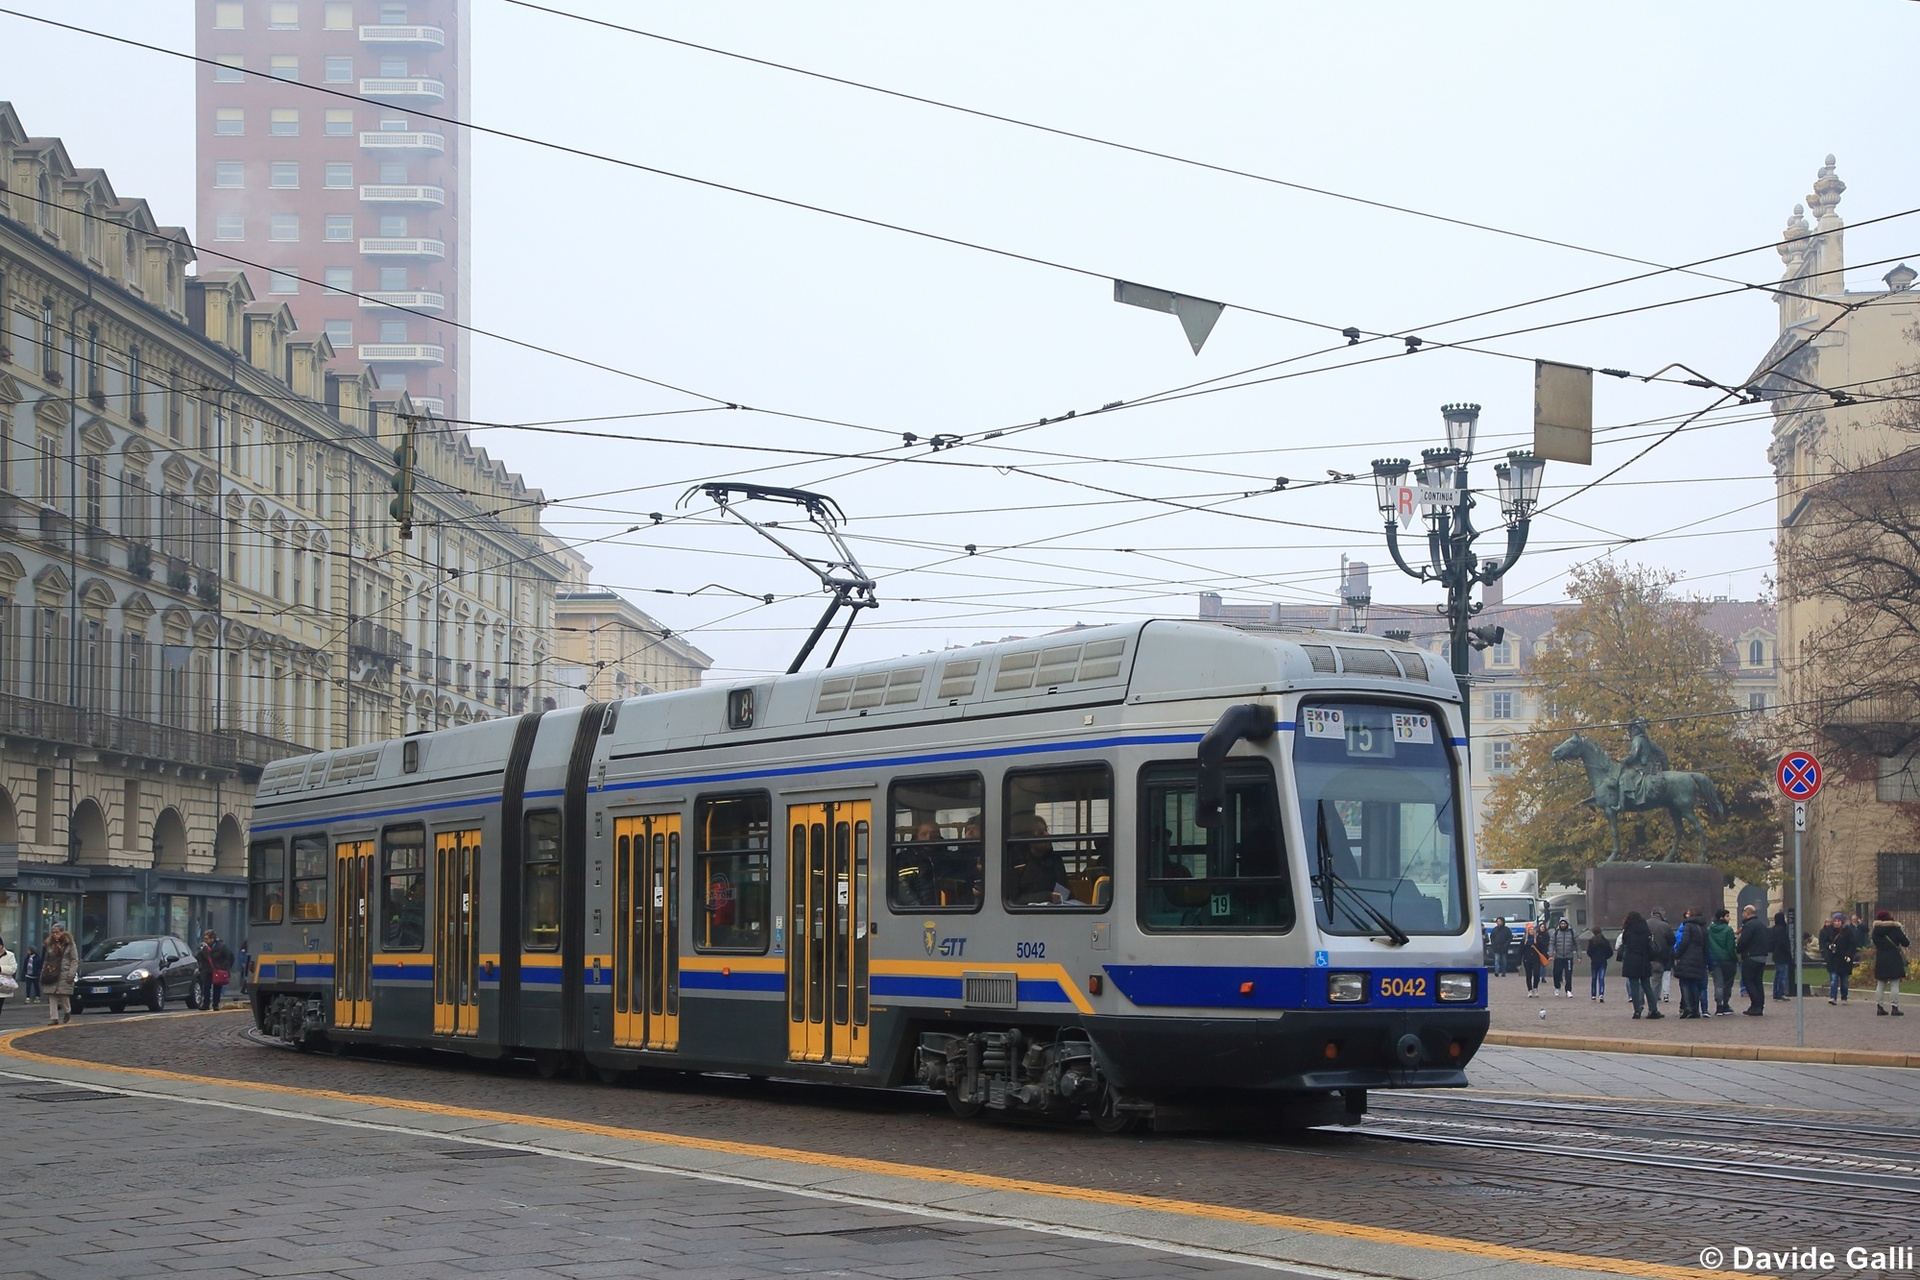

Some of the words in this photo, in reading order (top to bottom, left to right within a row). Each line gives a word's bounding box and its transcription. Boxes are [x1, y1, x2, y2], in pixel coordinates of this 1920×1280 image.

[1399, 487, 1413, 515] R
[1424, 491, 1454, 502] CONTINUA
[1307, 710, 1340, 723] EXPO
[1395, 715, 1428, 728] EXPO
[1212, 896, 1228, 914] 19
[1016, 942, 1046, 959] 5042
[1381, 977, 1426, 997] 5042
